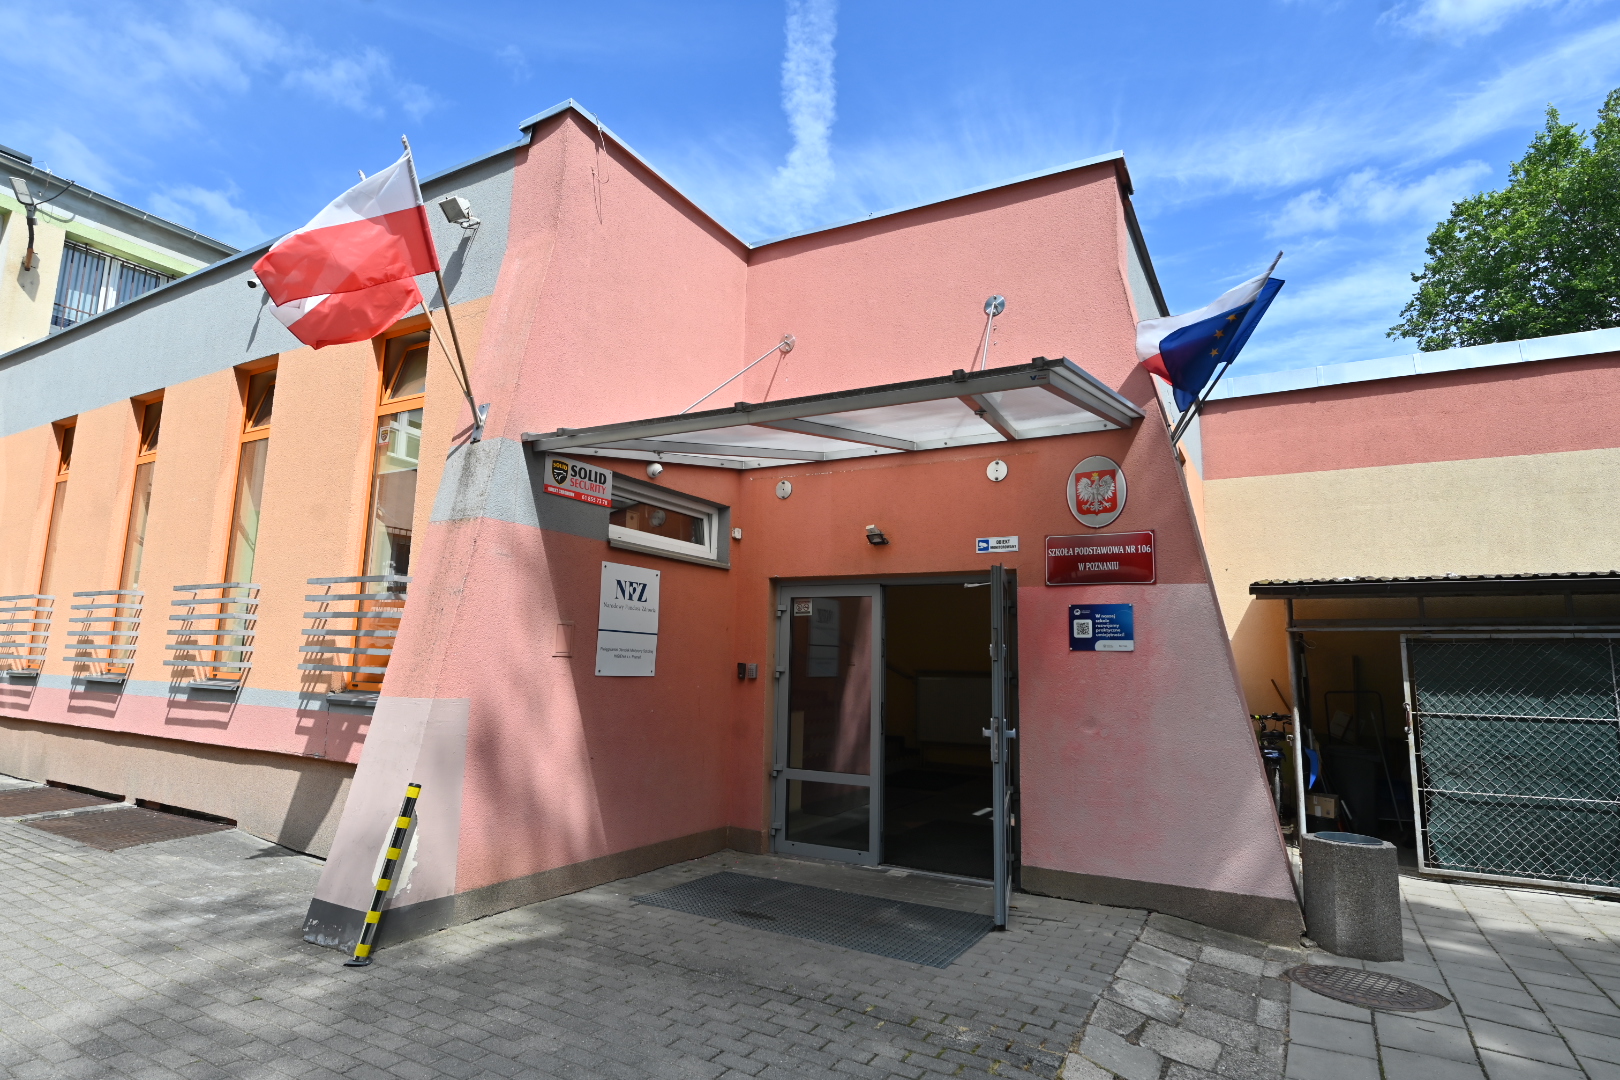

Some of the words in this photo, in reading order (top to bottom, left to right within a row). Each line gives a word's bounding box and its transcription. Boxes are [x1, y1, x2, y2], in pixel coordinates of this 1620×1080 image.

[553, 462, 568, 470] SOLID
[570, 464, 606, 485] SOLID
[570, 478, 606, 494] SECURITY
[1048, 547, 1073, 556] SZKOŁA
[1075, 546, 1124, 555] PODSTAWOWA
[1137, 545, 1151, 553] 106
[1078, 563, 1085, 571] W
[1086, 562, 1119, 571] POZNANIU
[615, 579, 648, 602] NFZ
